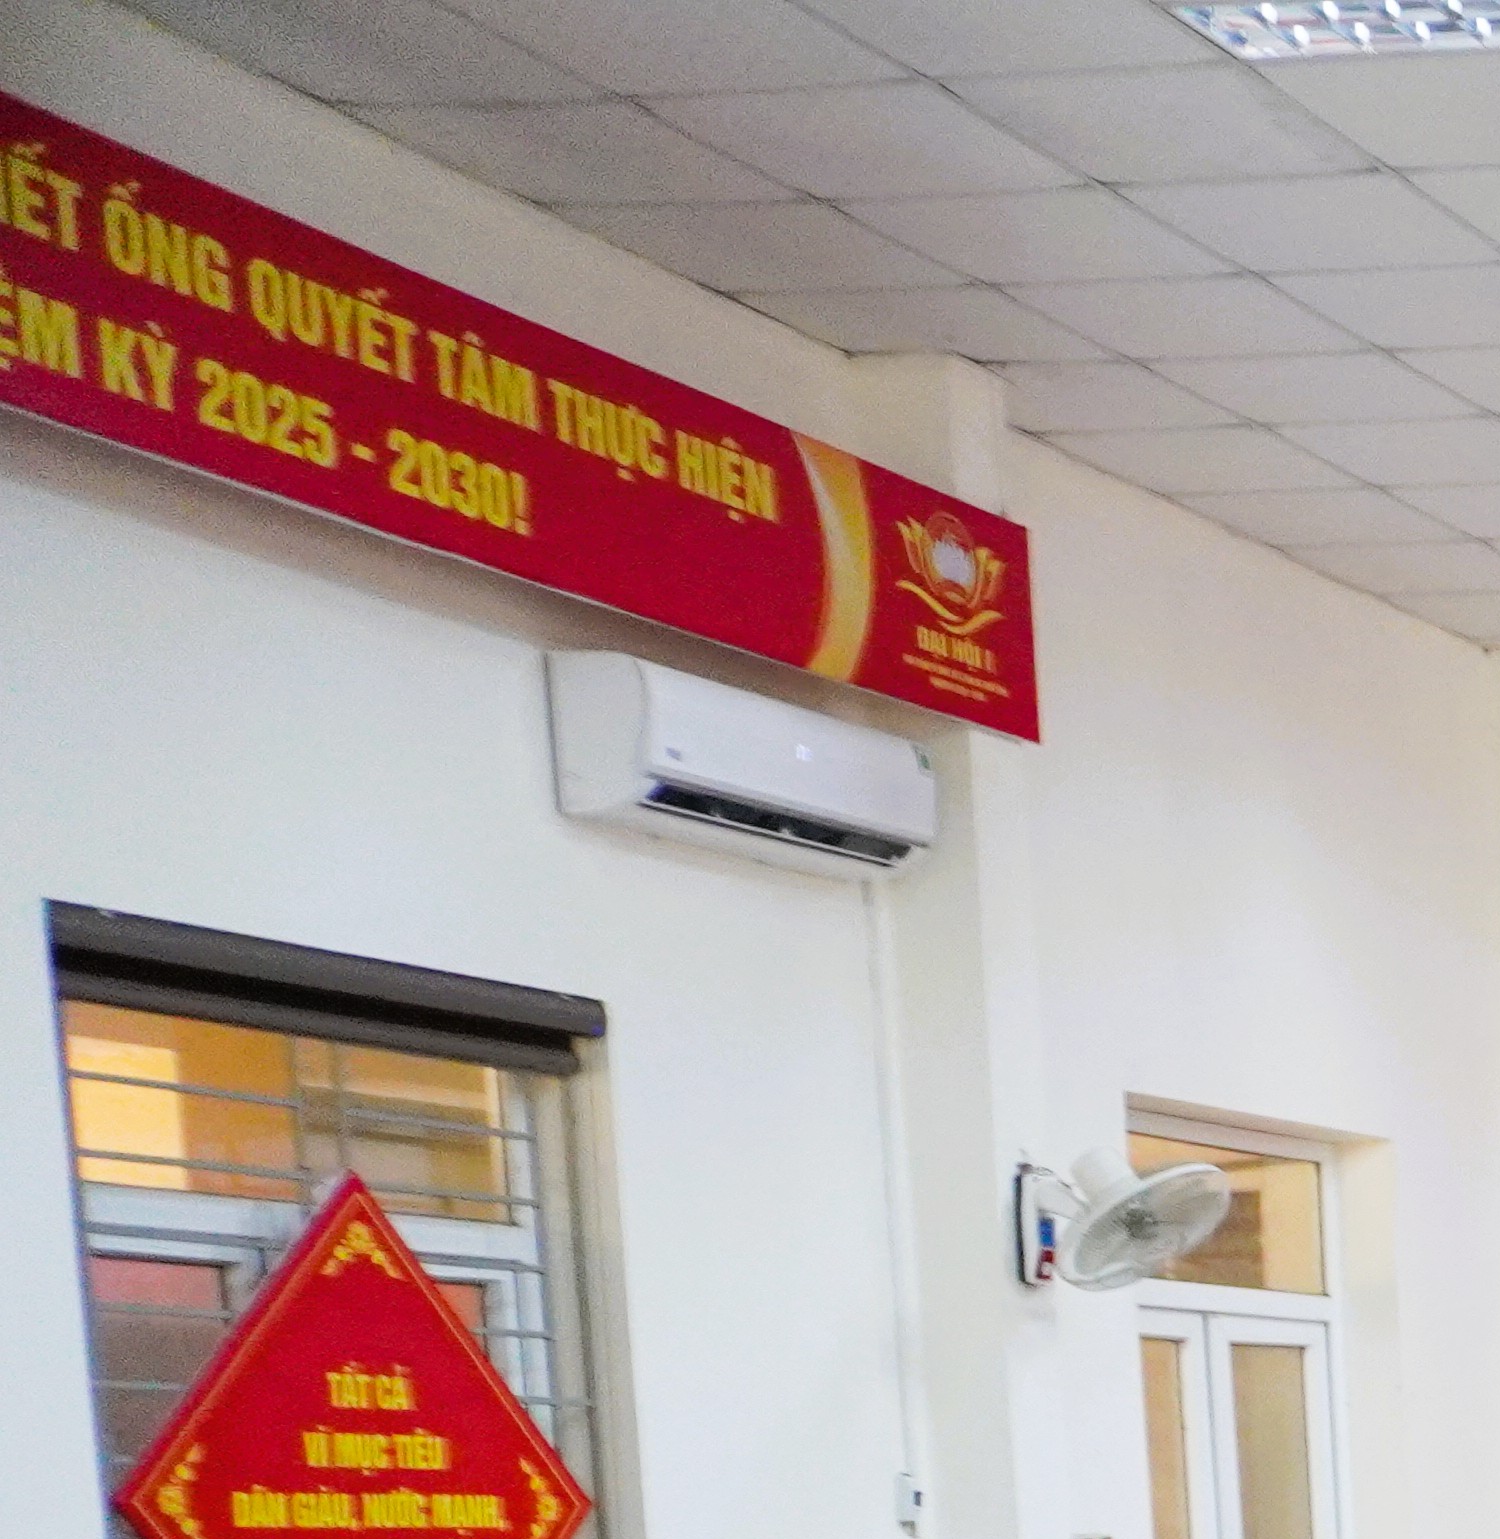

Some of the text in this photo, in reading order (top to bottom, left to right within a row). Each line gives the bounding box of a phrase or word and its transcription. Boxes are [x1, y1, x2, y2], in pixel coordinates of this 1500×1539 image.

[100, 320, 178, 412] KỲ
[196, 358, 338, 470] 2025
[351, 440, 373, 460] -
[388, 428, 532, 536] 2030!
[103, 181, 234, 313] ỐNG
[247, 258, 418, 383] QUYẾT
[427, 331, 541, 432] TÂM
[547, 377, 669, 483] THỰC
[675, 436, 779, 523] HIỆN
